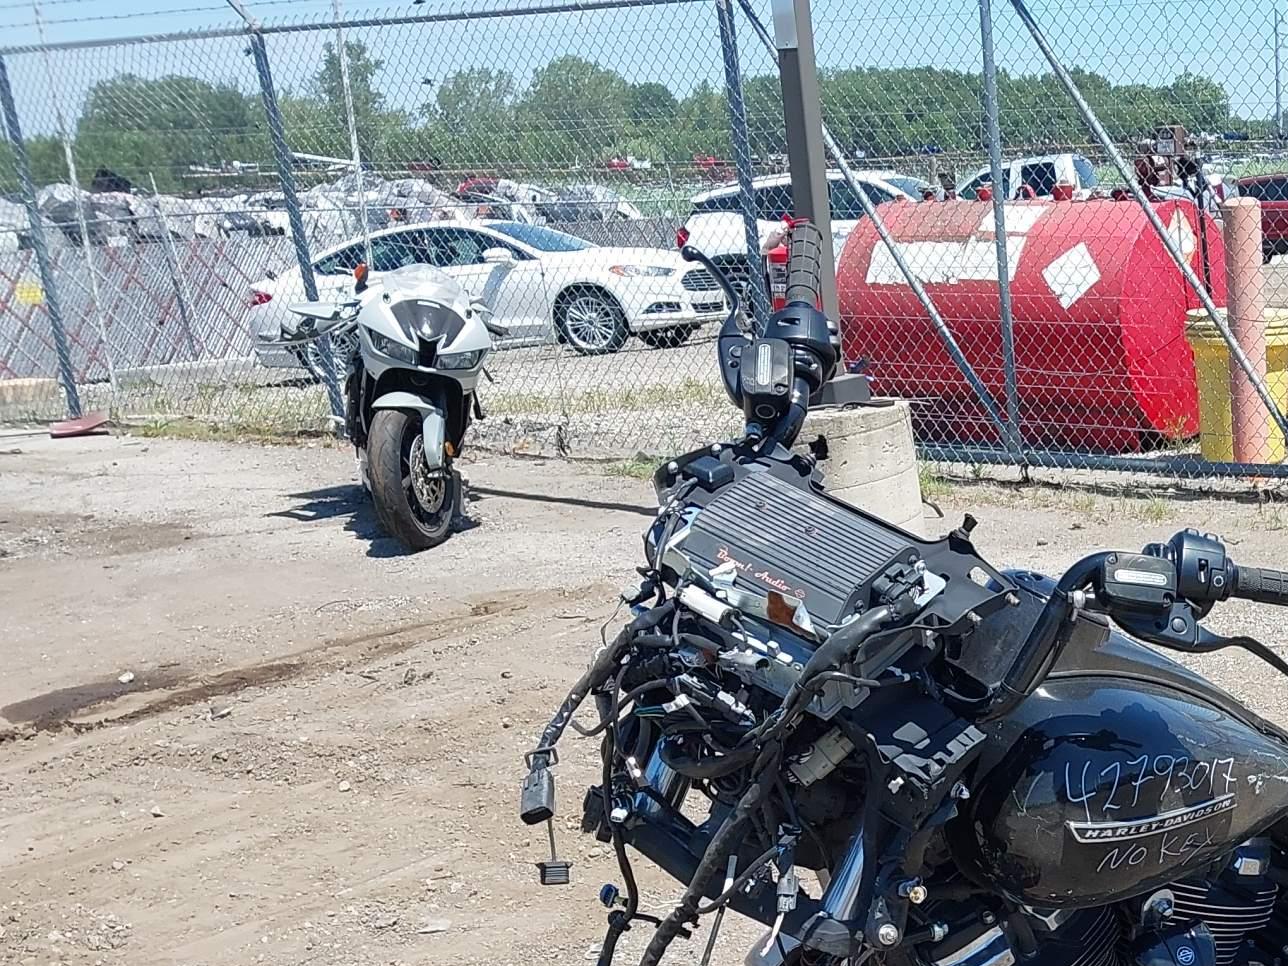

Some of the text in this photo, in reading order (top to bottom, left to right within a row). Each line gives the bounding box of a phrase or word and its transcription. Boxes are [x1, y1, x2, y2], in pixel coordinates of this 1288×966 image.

[754, 571, 791, 592] Audio
[1064, 754, 1238, 825] 42793017
[1084, 799, 1232, 838] HARLEY-DAVIDSON
[1096, 843, 1148, 873] NO
